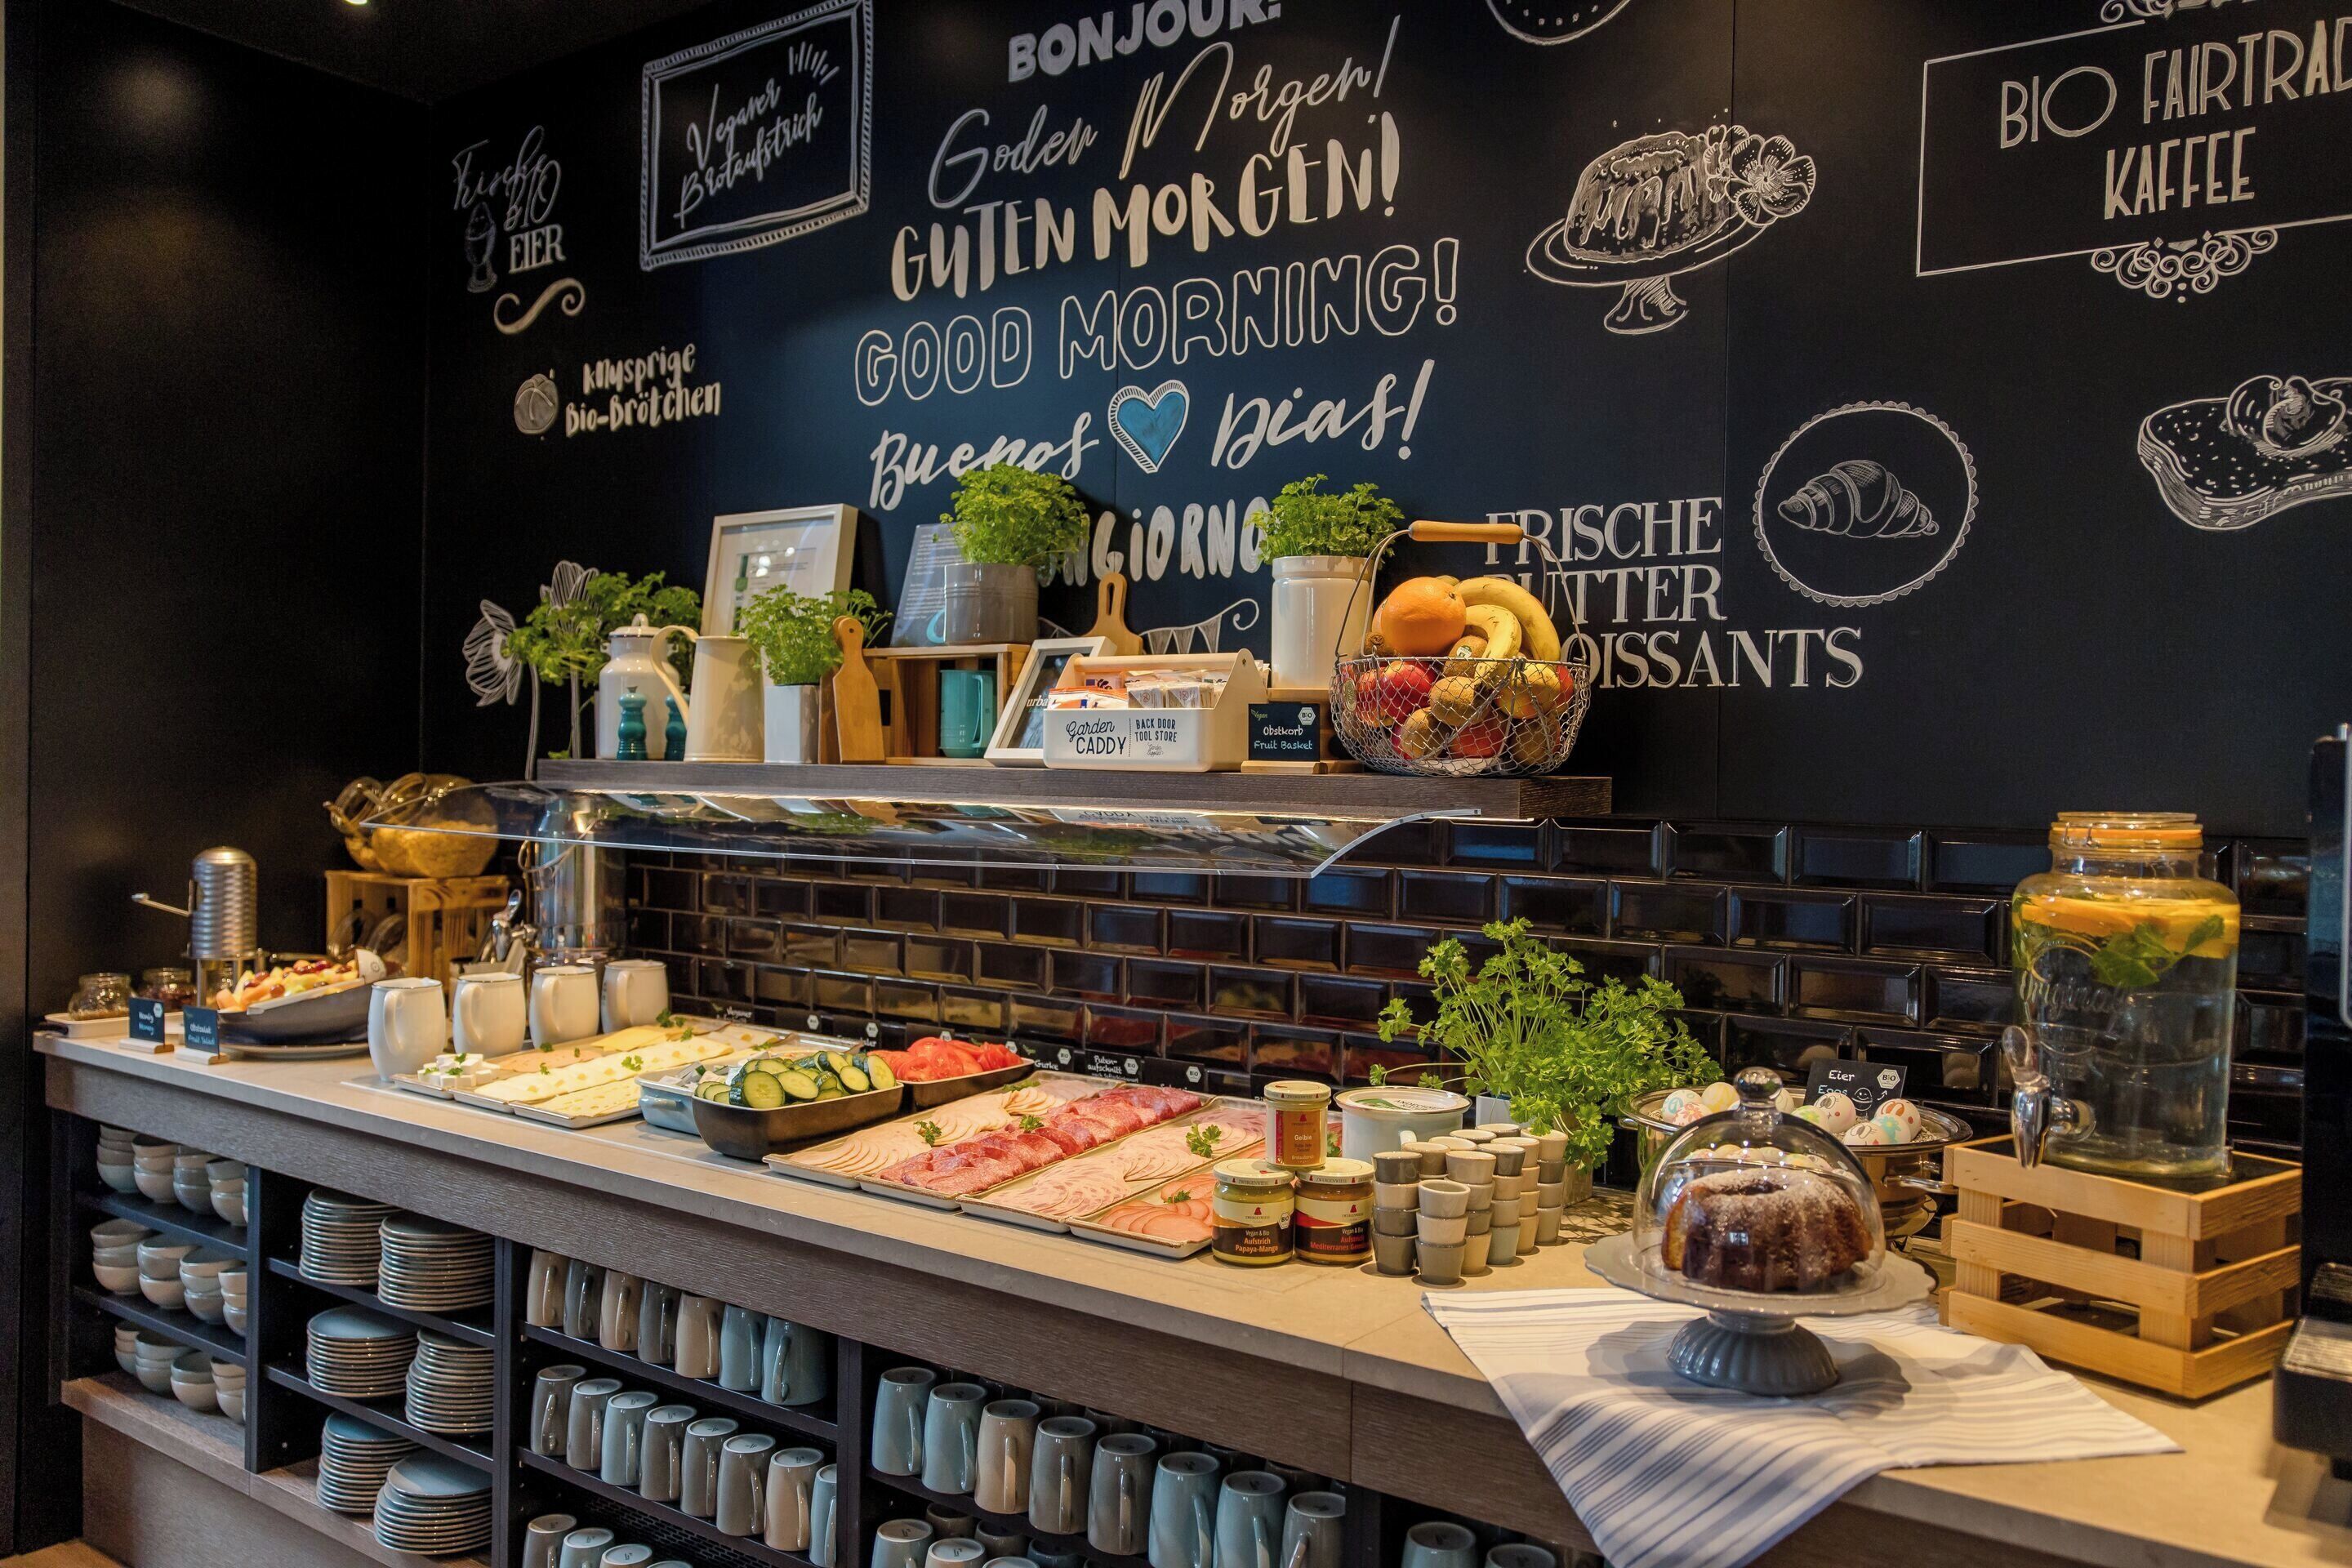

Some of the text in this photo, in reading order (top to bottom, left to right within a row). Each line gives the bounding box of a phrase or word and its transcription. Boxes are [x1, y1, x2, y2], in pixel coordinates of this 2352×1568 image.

[686, 78, 781, 171] Veganer
[928, 15, 1401, 208] Goden Morgen!
[2000, 66, 2117, 149] BIO
[673, 92, 823, 229] Brotaufstrich
[2104, 127, 2256, 220] KAFFEE
[891, 111, 1401, 301] GUTEN MORGEN!
[509, 224, 566, 274] EIER
[854, 237, 1460, 407] GOOD MORNING!
[1485, 497, 1723, 565] FRISCHE
[1488, 564, 1727, 626] UTTER
[1560, 626, 1864, 689] OISSANTS
[1066, 718, 1115, 743] Garden
[1134, 730, 1178, 742] TOOL STORE
[1135, 718, 1176, 730] BACK DOOR
[1263, 724, 1303, 736] Obstkorb
[1076, 736, 1127, 755] CADDY
[1254, 740, 1313, 750] Fruit Basket
[1034, 1058, 1059, 1071] Gurke
[1829, 1069, 1855, 1082] Eier
[1235, 1244, 1279, 1254] Papaya-Mango
[1244, 1237, 1271, 1245] Aufstrich
[1245, 1230, 1258, 1238] Vegan
